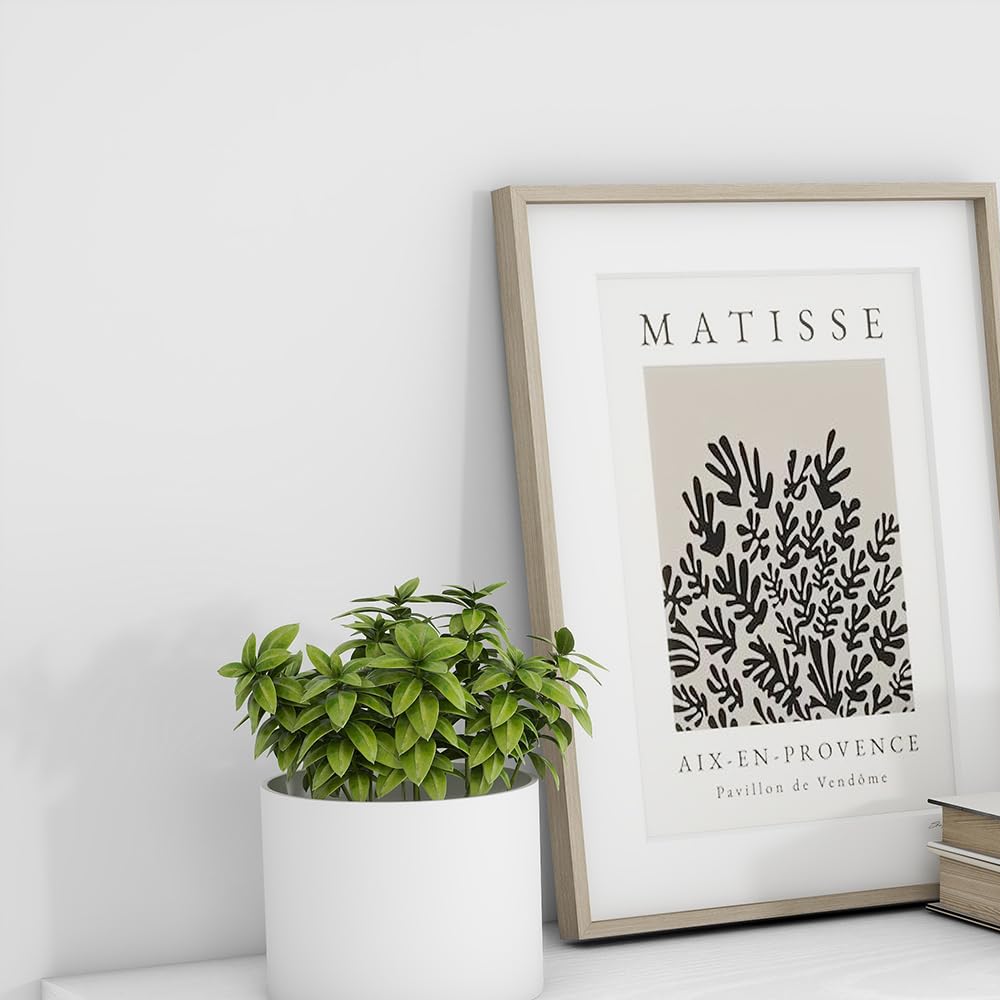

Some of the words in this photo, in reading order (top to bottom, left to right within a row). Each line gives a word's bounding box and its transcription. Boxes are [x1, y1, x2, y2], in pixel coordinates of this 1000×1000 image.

[639, 307, 883, 346] MATISSE
[678, 734, 920, 773] AIX-EN-PROVENCE
[716, 781, 784, 799] Pavillon
[793, 778, 809, 792] de
[817, 773, 889, 790] Vendôme
